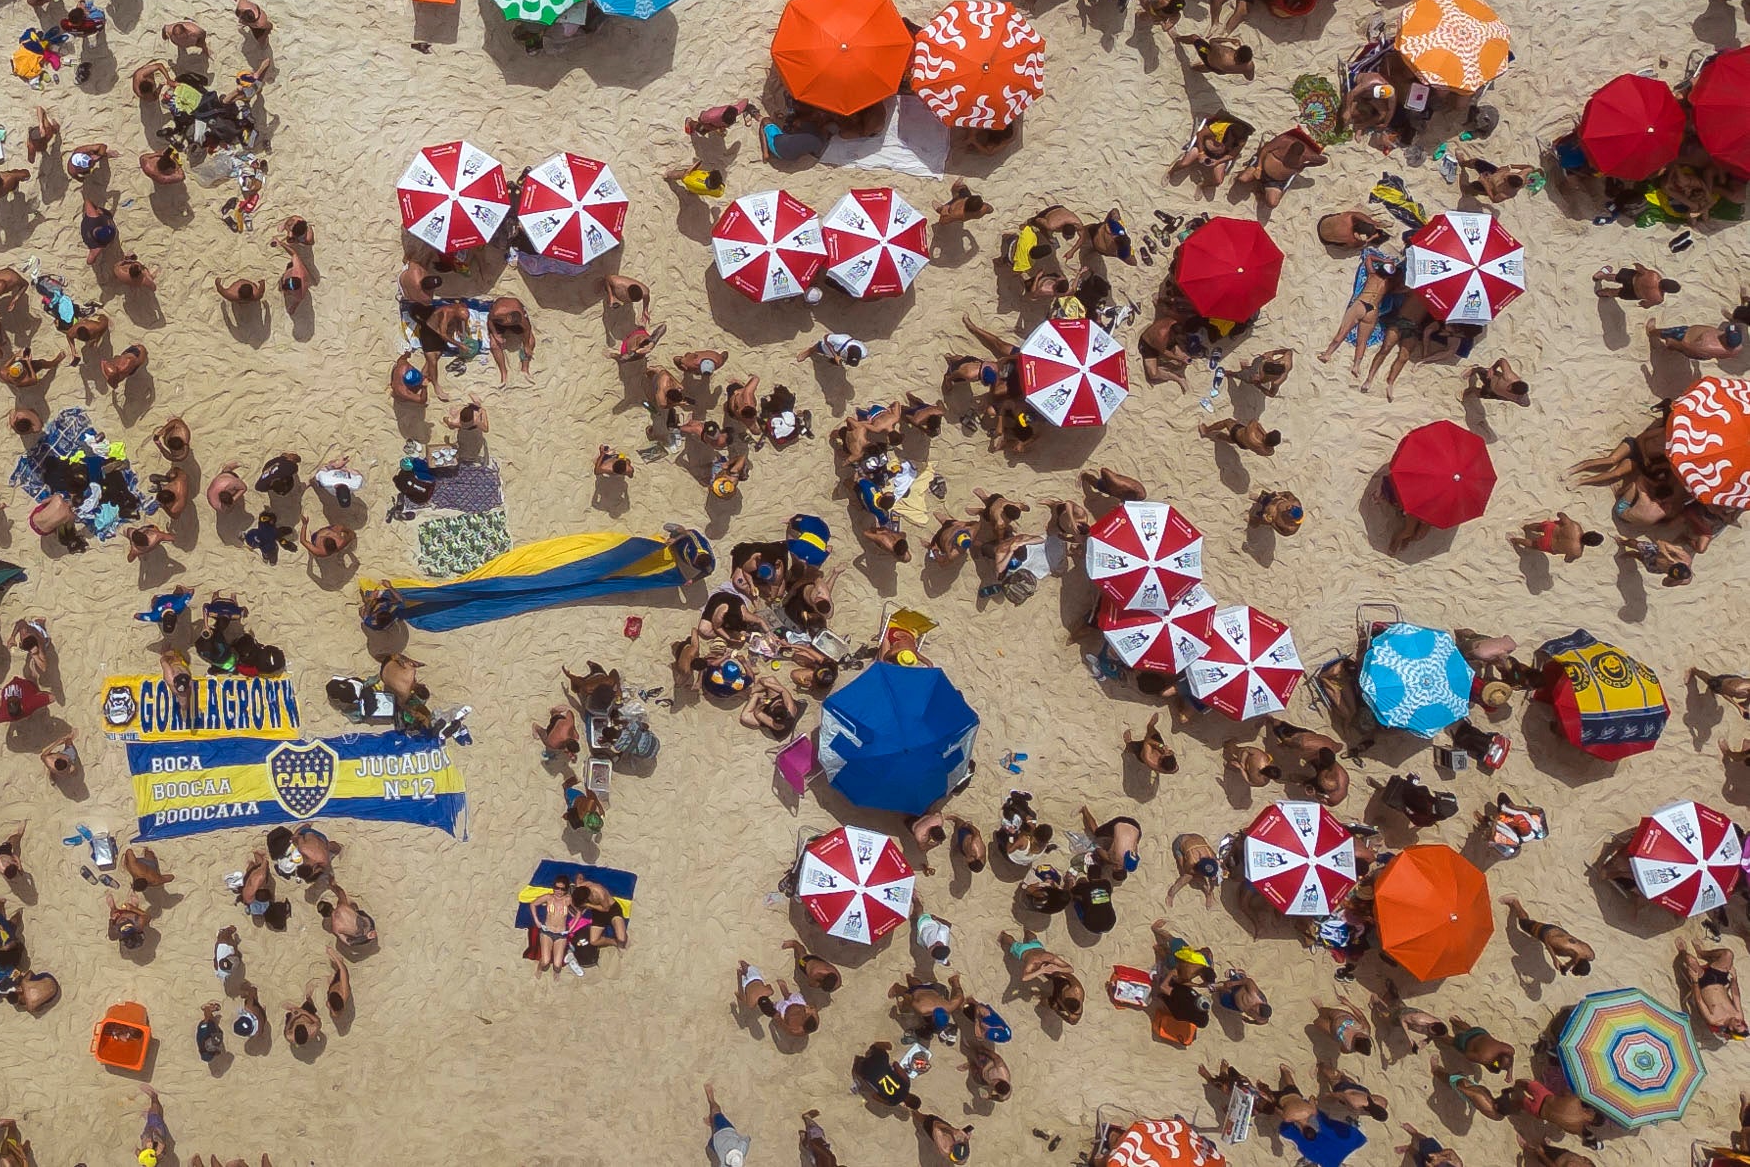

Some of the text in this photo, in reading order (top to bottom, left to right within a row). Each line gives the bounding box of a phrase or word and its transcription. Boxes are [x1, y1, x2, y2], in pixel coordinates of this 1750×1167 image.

[151, 756, 202, 774] BOCA
[153, 778, 232, 801] BOOCAA
[154, 801, 259, 826] BOOOCAAA
